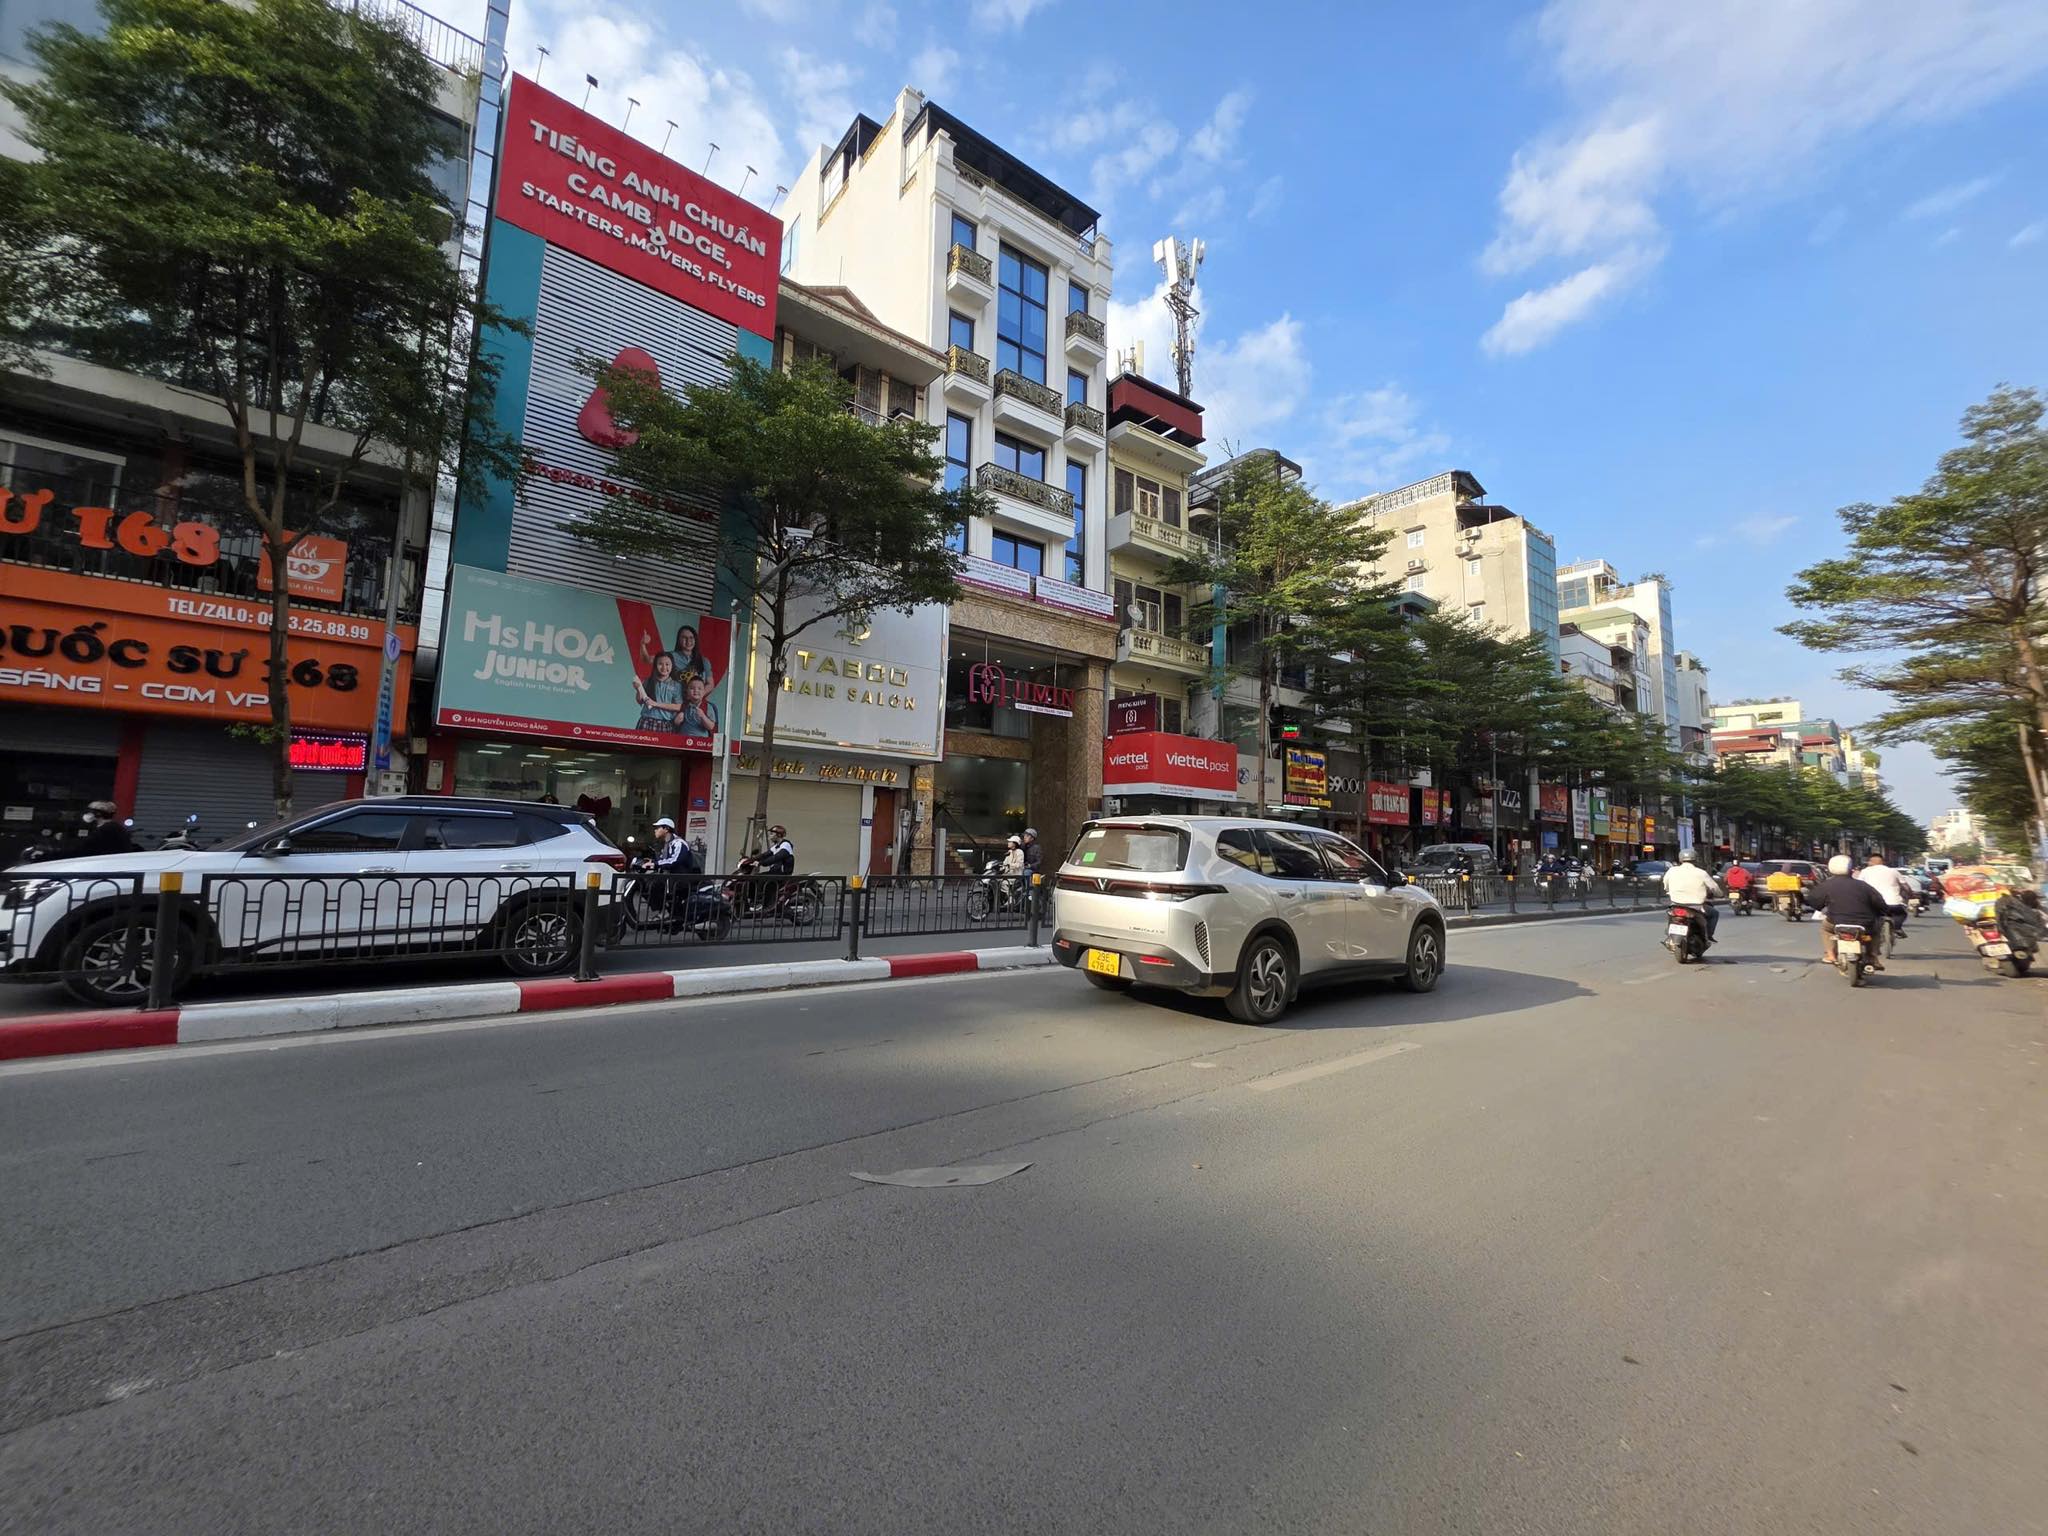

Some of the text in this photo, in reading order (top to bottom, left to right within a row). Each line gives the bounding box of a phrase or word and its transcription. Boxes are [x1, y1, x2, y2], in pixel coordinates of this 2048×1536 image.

[530, 118, 767, 258] TIẾNG ANH CHUẨN
[708, 270, 767, 308] FLYERS
[72, 506, 220, 566] 168
[168, 598, 370, 640] TEL/ZALO: 03.25.88.99
[463, 609, 616, 664] Ms HOA
[0, 621, 359, 692] UỐC SƯ 68
[141, 682, 216, 704] CƠM
[782, 676, 916, 711] HAIR SALON
[1109, 751, 1149, 766] viettel
[1135, 763, 1149, 771] post
[1165, 751, 1230, 773] viettel post
